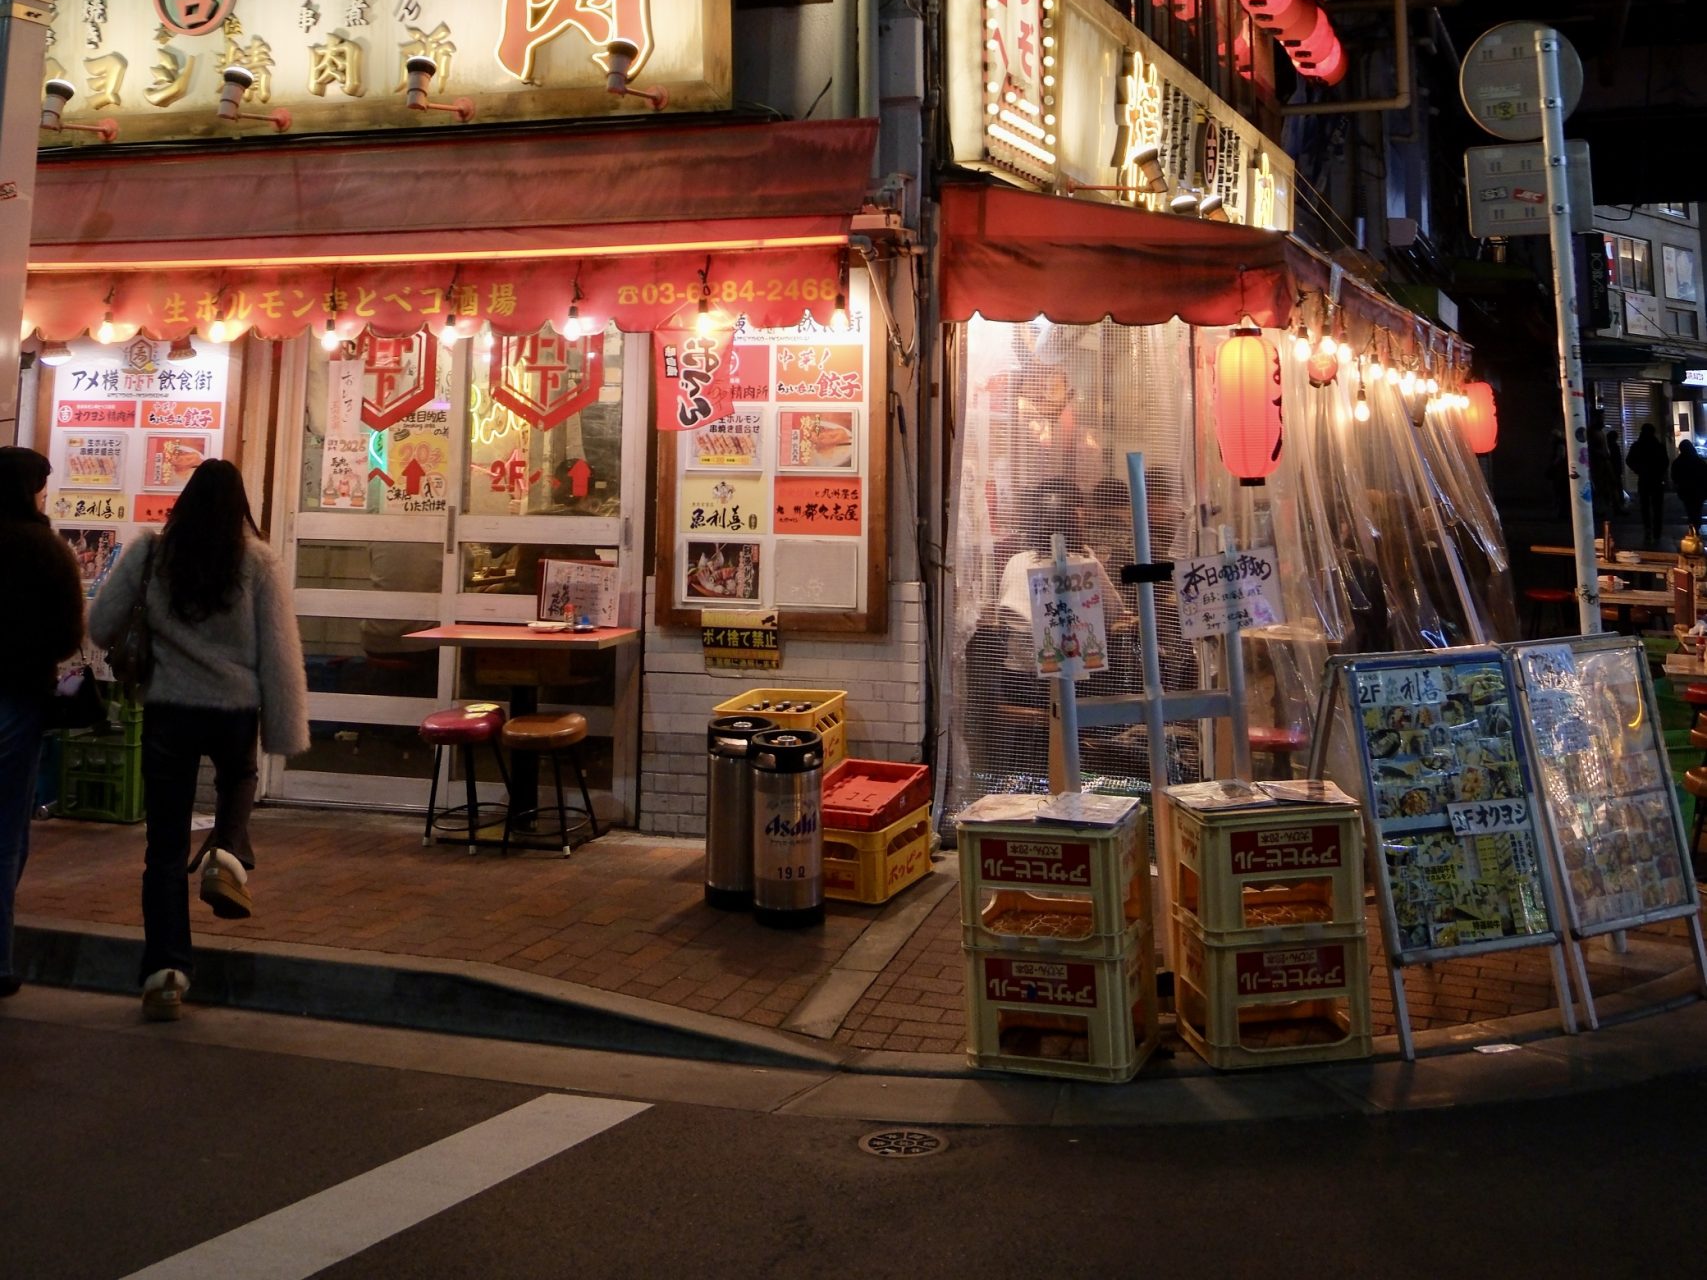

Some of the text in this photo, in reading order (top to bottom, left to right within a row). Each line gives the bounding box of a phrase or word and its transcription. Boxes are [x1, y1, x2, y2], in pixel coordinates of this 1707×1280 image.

[703, 629, 777, 648] ポイ捨て禁止
[765, 809, 817, 837] Asahi
[1234, 845, 1338, 869] アサヒビール
[984, 858, 1088, 882] アサヒビール
[1240, 966, 1342, 990] アサヒビール
